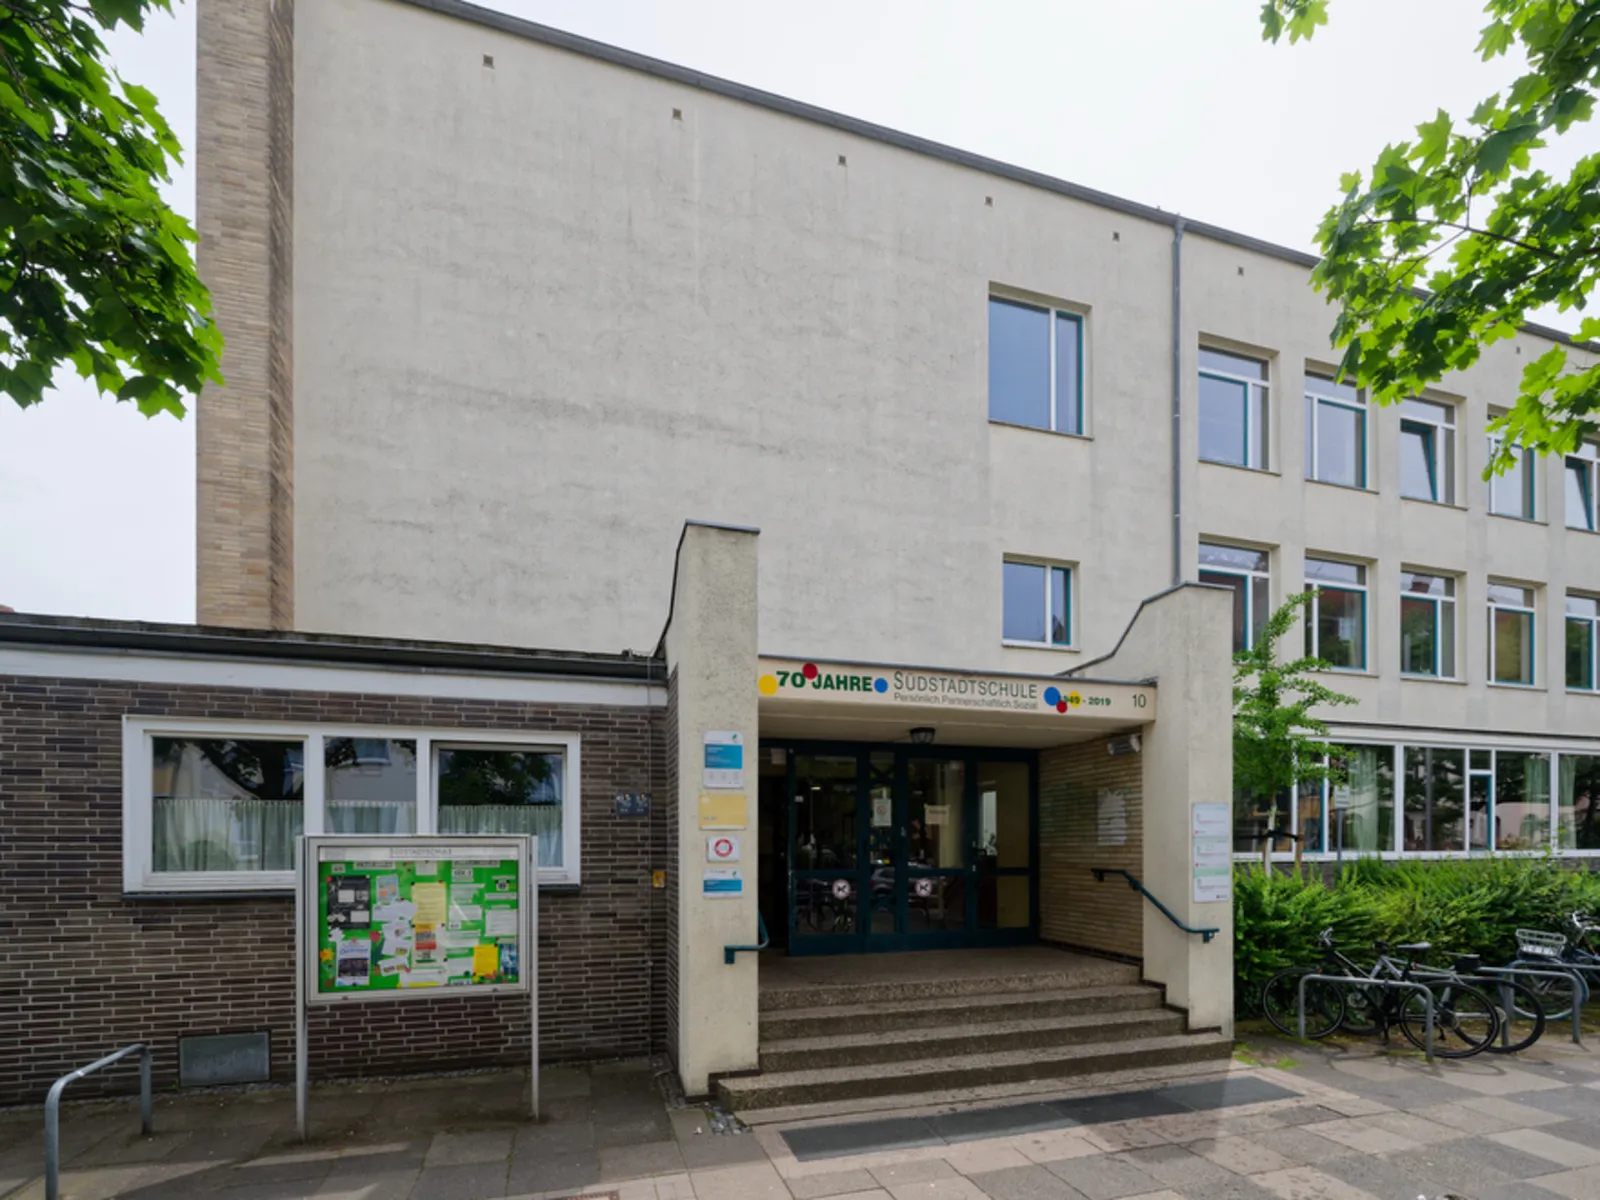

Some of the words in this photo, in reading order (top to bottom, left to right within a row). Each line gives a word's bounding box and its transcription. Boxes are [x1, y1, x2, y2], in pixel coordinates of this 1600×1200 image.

[776, 671, 805, 688] 70
[812, 673, 873, 692] JAHRE
[893, 670, 1038, 699] SÜDSTADTSCHULE
[1088, 696, 1112, 706] 2019
[1132, 694, 1147, 708] 10
